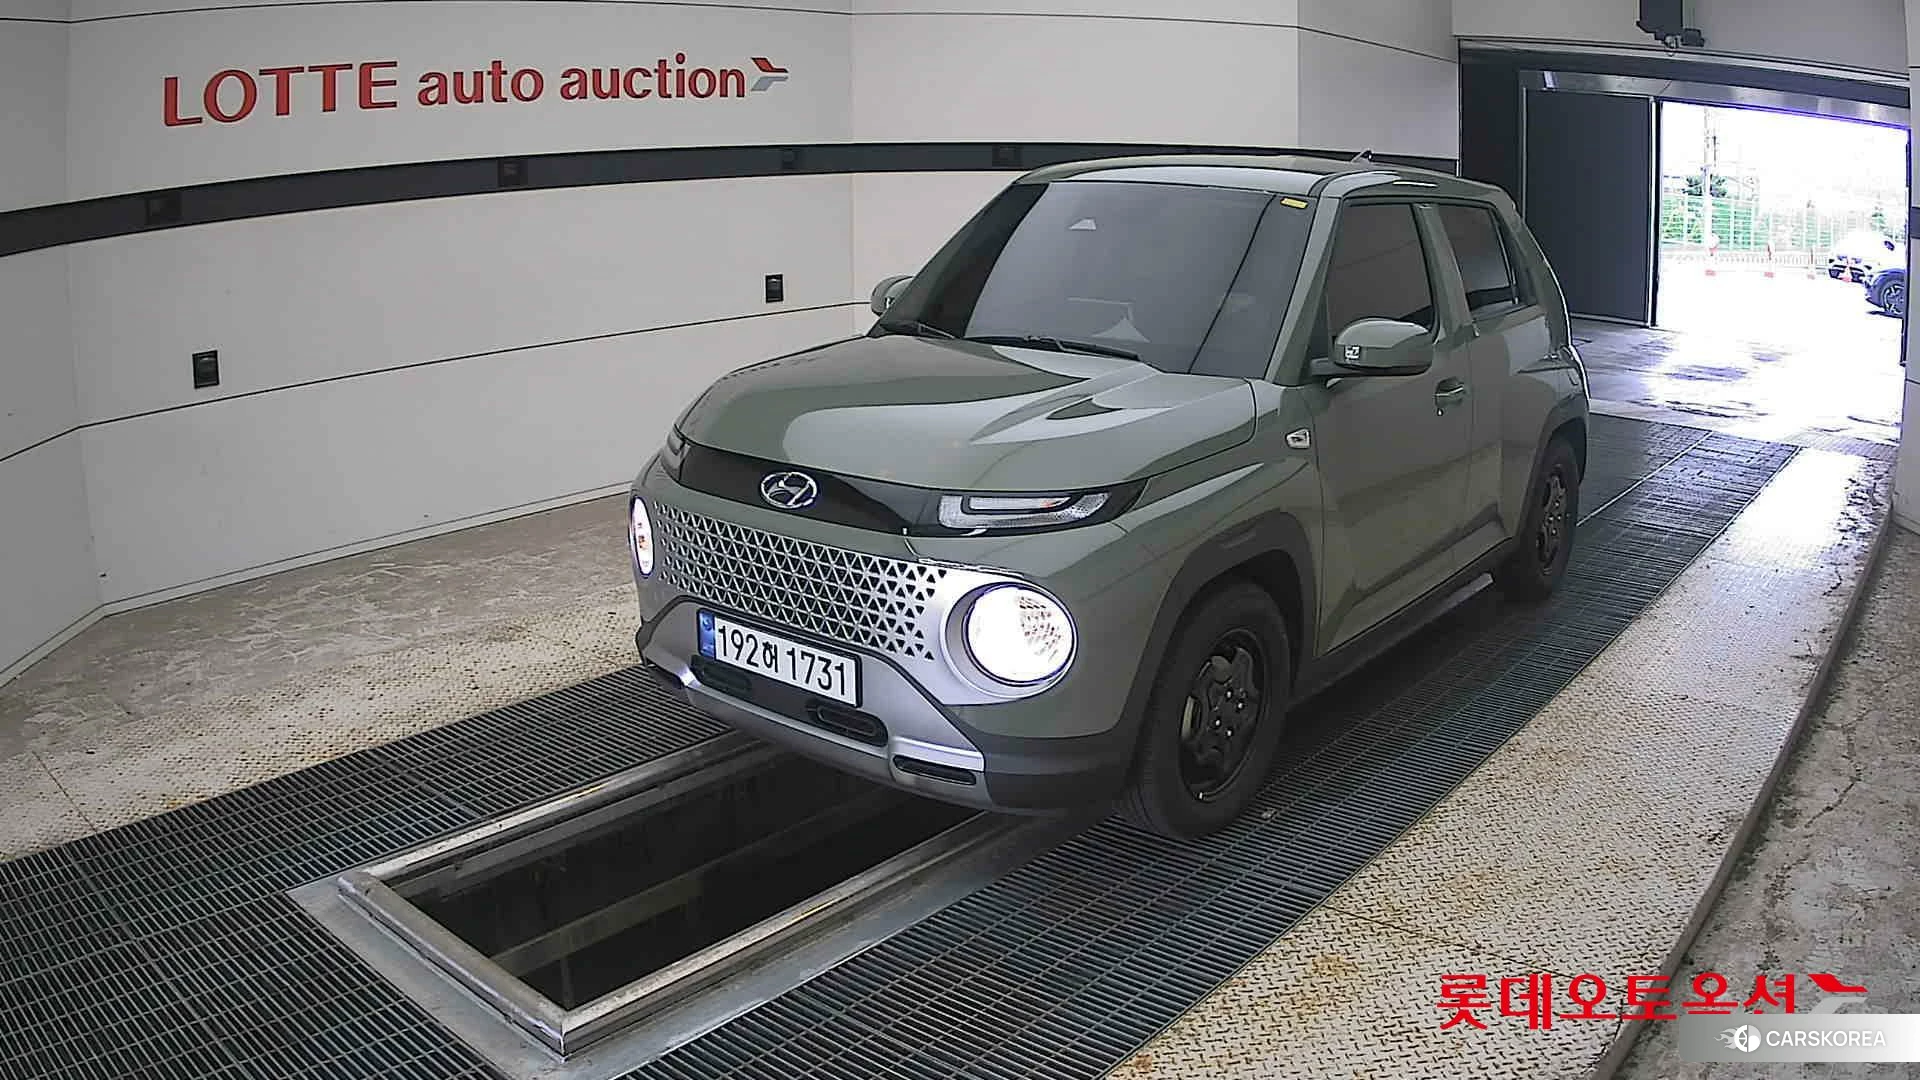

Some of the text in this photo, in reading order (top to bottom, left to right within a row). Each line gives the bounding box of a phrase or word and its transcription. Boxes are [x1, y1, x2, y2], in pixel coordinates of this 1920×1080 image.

[163, 53, 746, 127] LOTTE auto auction
[718, 624, 846, 697] 192허 1731
